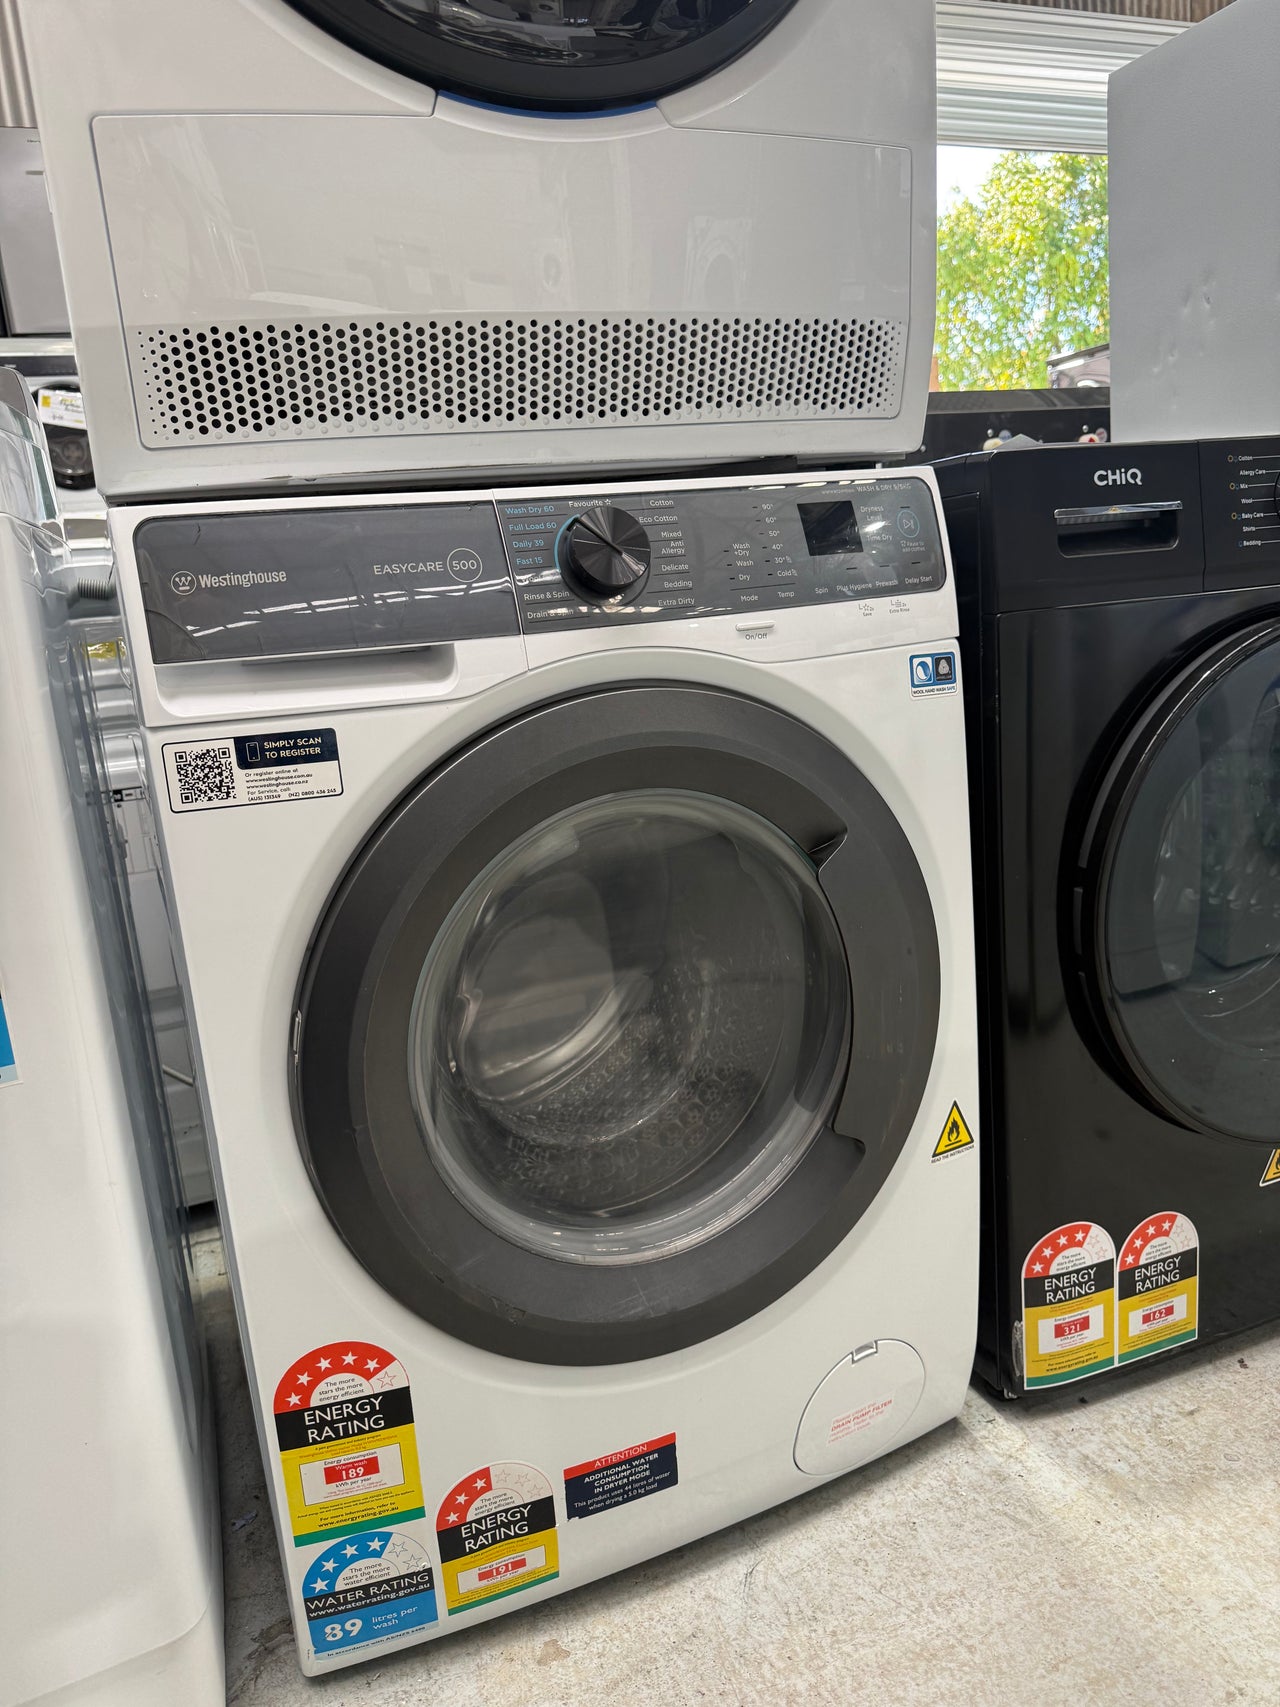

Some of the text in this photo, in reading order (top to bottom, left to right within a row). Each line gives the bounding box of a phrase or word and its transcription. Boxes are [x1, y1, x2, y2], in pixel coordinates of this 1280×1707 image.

[1093, 468, 1143, 486] CHiQ
[569, 499, 603, 508] Favourite
[650, 499, 674, 507] Cotton
[505, 507, 527, 515] Wash
[529, 506, 542, 515] Dry
[860, 505, 884, 513] Dryness
[639, 516, 653, 524] Eco
[509, 523, 524, 531] Full
[661, 530, 682, 538] Mixed
[512, 540, 532, 548] Daily
[732, 542, 750, 550] Wash
[661, 547, 685, 556] Allergy
[734, 549, 749, 557] +Dry
[452, 558, 477, 571] 500
[516, 557, 531, 565] Fast
[373, 561, 444, 576] EASYCARE
[661, 563, 689, 571] Delicate
[777, 569, 792, 577] Cold
[199, 569, 287, 589] Westinghouse
[664, 580, 693, 589] Bedding
[849, 582, 873, 592] Hygiene
[777, 590, 794, 598] Temp
[815, 586, 829, 594] Spin
[524, 593, 545, 601] Rinse
[552, 591, 570, 599] Spin
[658, 597, 695, 607] Extra Dirty
[527, 611, 548, 619] Drain
[745, 632, 769, 641] On/Off
[264, 737, 322, 749] SIMPLY SCAN
[265, 747, 321, 759] TO REGISTER
[246, 774, 313, 783] www.westinghouse.com.au
[246, 780, 309, 789] www.westinghouse.co.nz
[1135, 1256, 1181, 1280] ENERGY
[1044, 1267, 1097, 1291] ENERGY
[1136, 1270, 1180, 1294] RATING
[1046, 1281, 1095, 1304] RATING
[1150, 1309, 1166, 1321] 162
[1064, 1324, 1080, 1335] 321
[341, 1388, 364, 1397] efficient
[304, 1396, 383, 1426] ENERGY
[307, 1414, 385, 1443] RATING
[343, 1451, 377, 1461] consumption
[594, 1444, 647, 1469] ATTENTION
[584, 1453, 659, 1483] ADDITIONAL WATER
[342, 1467, 365, 1480] 189
[594, 1464, 650, 1487] CONSUMPTION
[604, 1479, 628, 1491] DRYER
[629, 1470, 651, 1482] MODE
[588, 1493, 610, 1505] product
[633, 1481, 647, 1489] litres
[654, 1471, 671, 1480] water
[605, 1495, 623, 1505] drying
[645, 1483, 658, 1491] load
[474, 1507, 493, 1516] energy
[318, 1506, 399, 1528] www.energyrating.gov.au
[461, 1505, 532, 1538] ENERGY
[465, 1522, 529, 1553] RATING
[364, 1563, 382, 1571] more
[372, 1567, 391, 1575] more
[493, 1563, 512, 1576] 191
[364, 1572, 391, 1582] efficient
[307, 1590, 366, 1610] WATER
[370, 1573, 429, 1595] RATING
[309, 1583, 430, 1617] www.waterrating.gov.au
[324, 1606, 418, 1642] 89 litres per
[373, 1620, 399, 1630] wash
